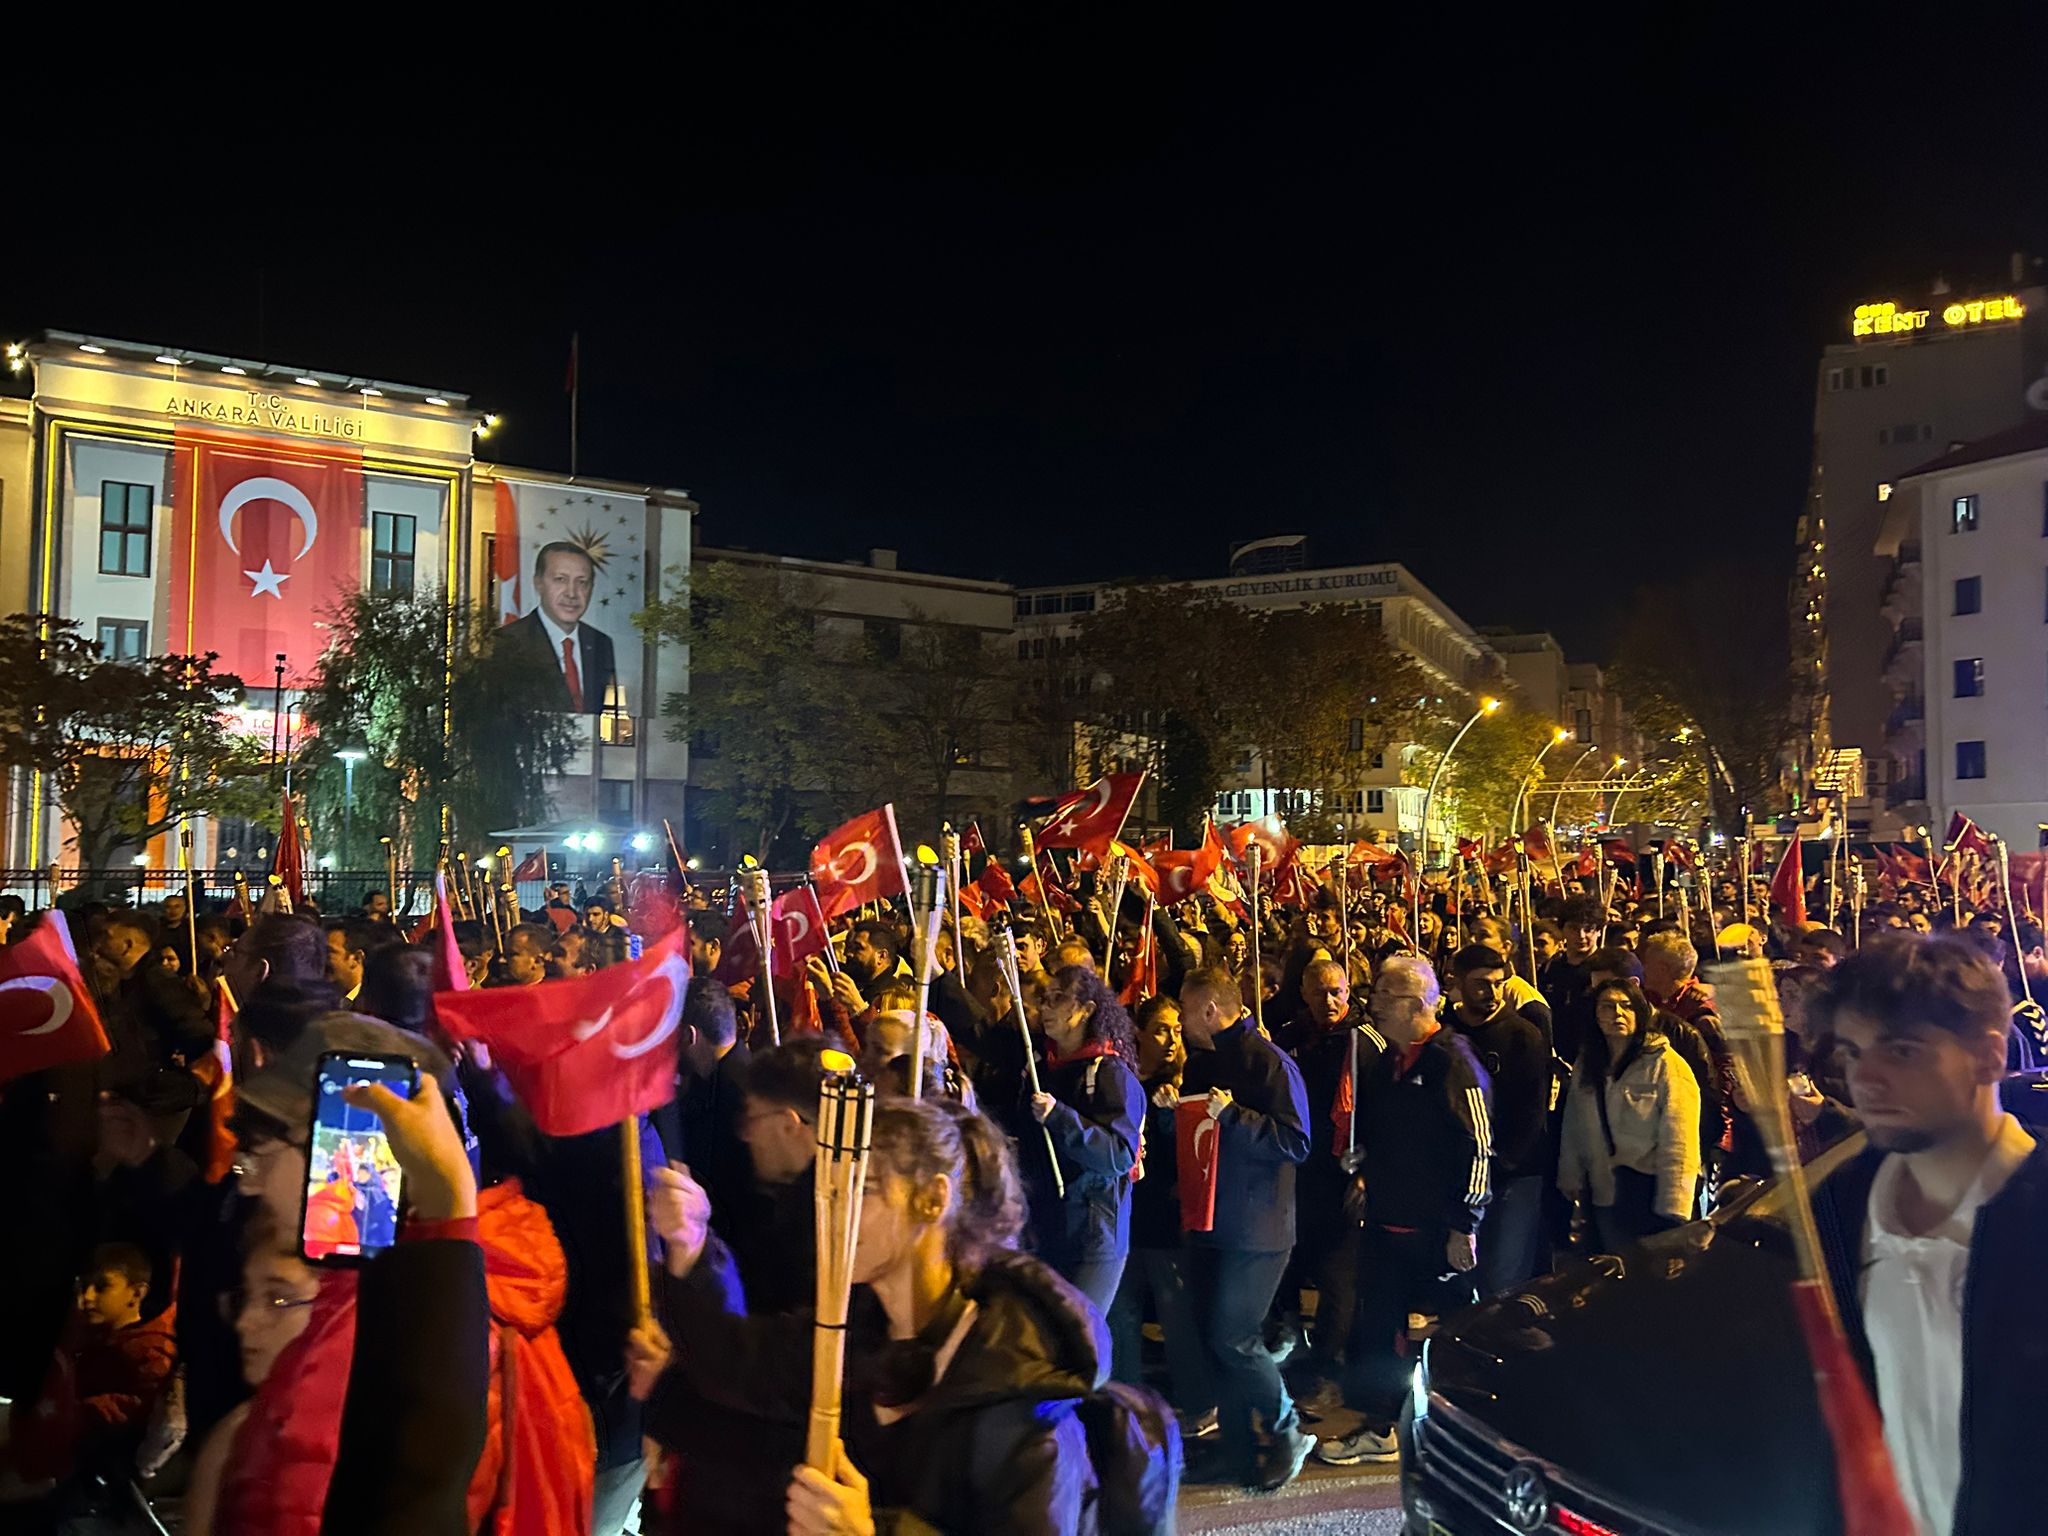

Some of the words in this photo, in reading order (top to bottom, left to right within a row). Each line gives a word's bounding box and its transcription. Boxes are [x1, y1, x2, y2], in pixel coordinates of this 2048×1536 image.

[1853, 311, 1930, 336] KENT
[1943, 298, 2023, 325] OTEL
[166, 396, 259, 423] ANKARA
[271, 411, 363, 438] VALİLİĞİ
[249, 392, 289, 411] T.C.
[1226, 578, 1313, 597] GÜVENLİK
[1319, 571, 1398, 590] KURUMU
